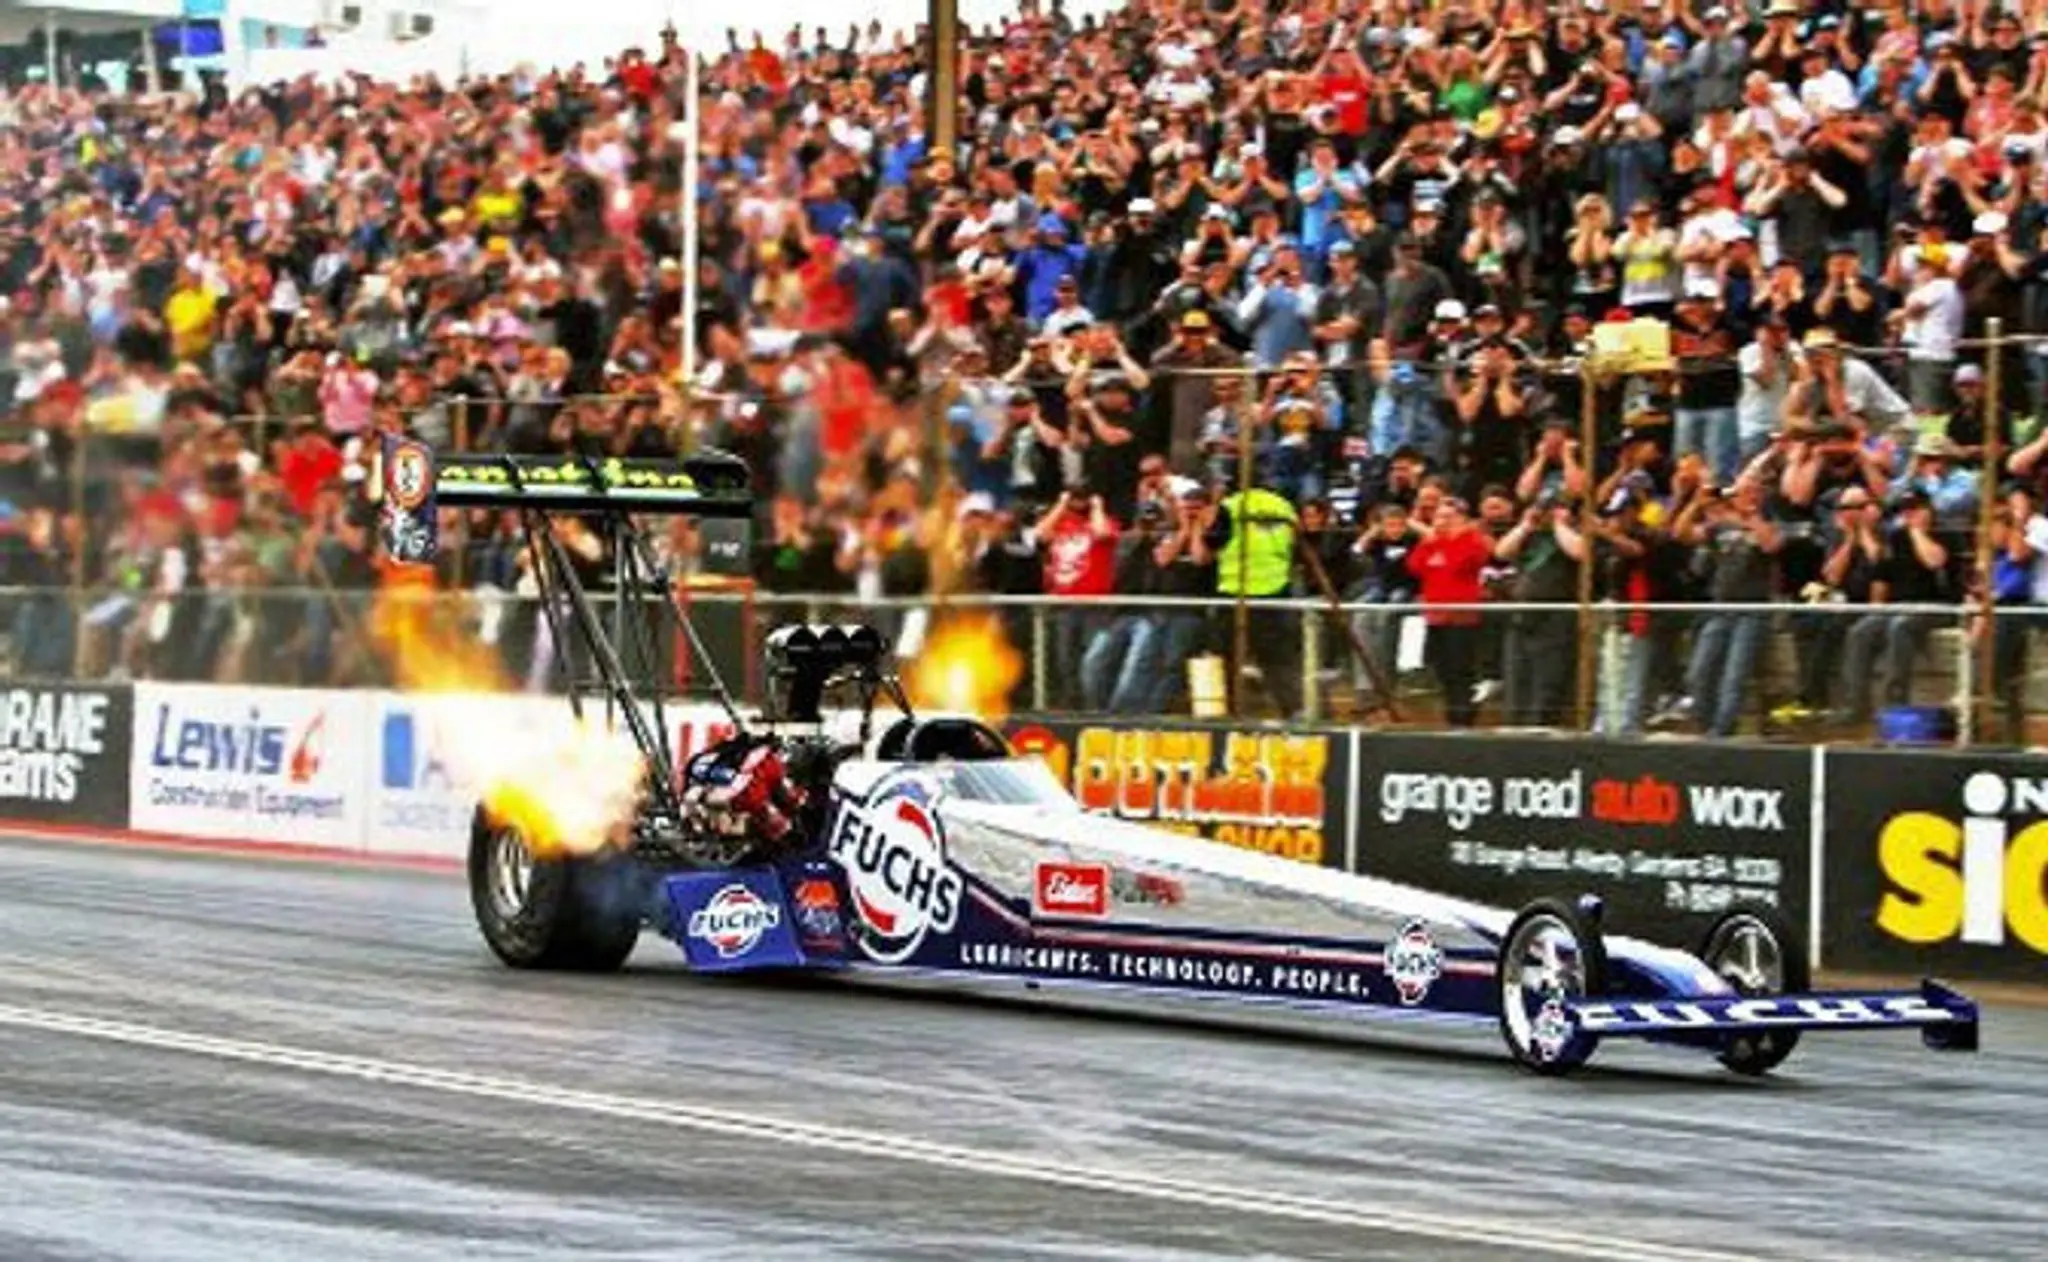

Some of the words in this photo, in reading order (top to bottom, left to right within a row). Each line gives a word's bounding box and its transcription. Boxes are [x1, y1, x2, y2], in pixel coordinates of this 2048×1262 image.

[0, 689, 111, 754] RANE
[153, 702, 287, 776] Lewis
[1380, 772, 1493, 830] grange
[1503, 768, 1581, 818] road
[1592, 775, 1679, 824] auto
[1689, 785, 1784, 830] worx
[831, 804, 958, 930] FUCHS
[689, 906, 779, 934] FUCHS
[1109, 953, 1262, 987] TECHNOLOGY.
[1272, 965, 1370, 997] PEOPLE.
